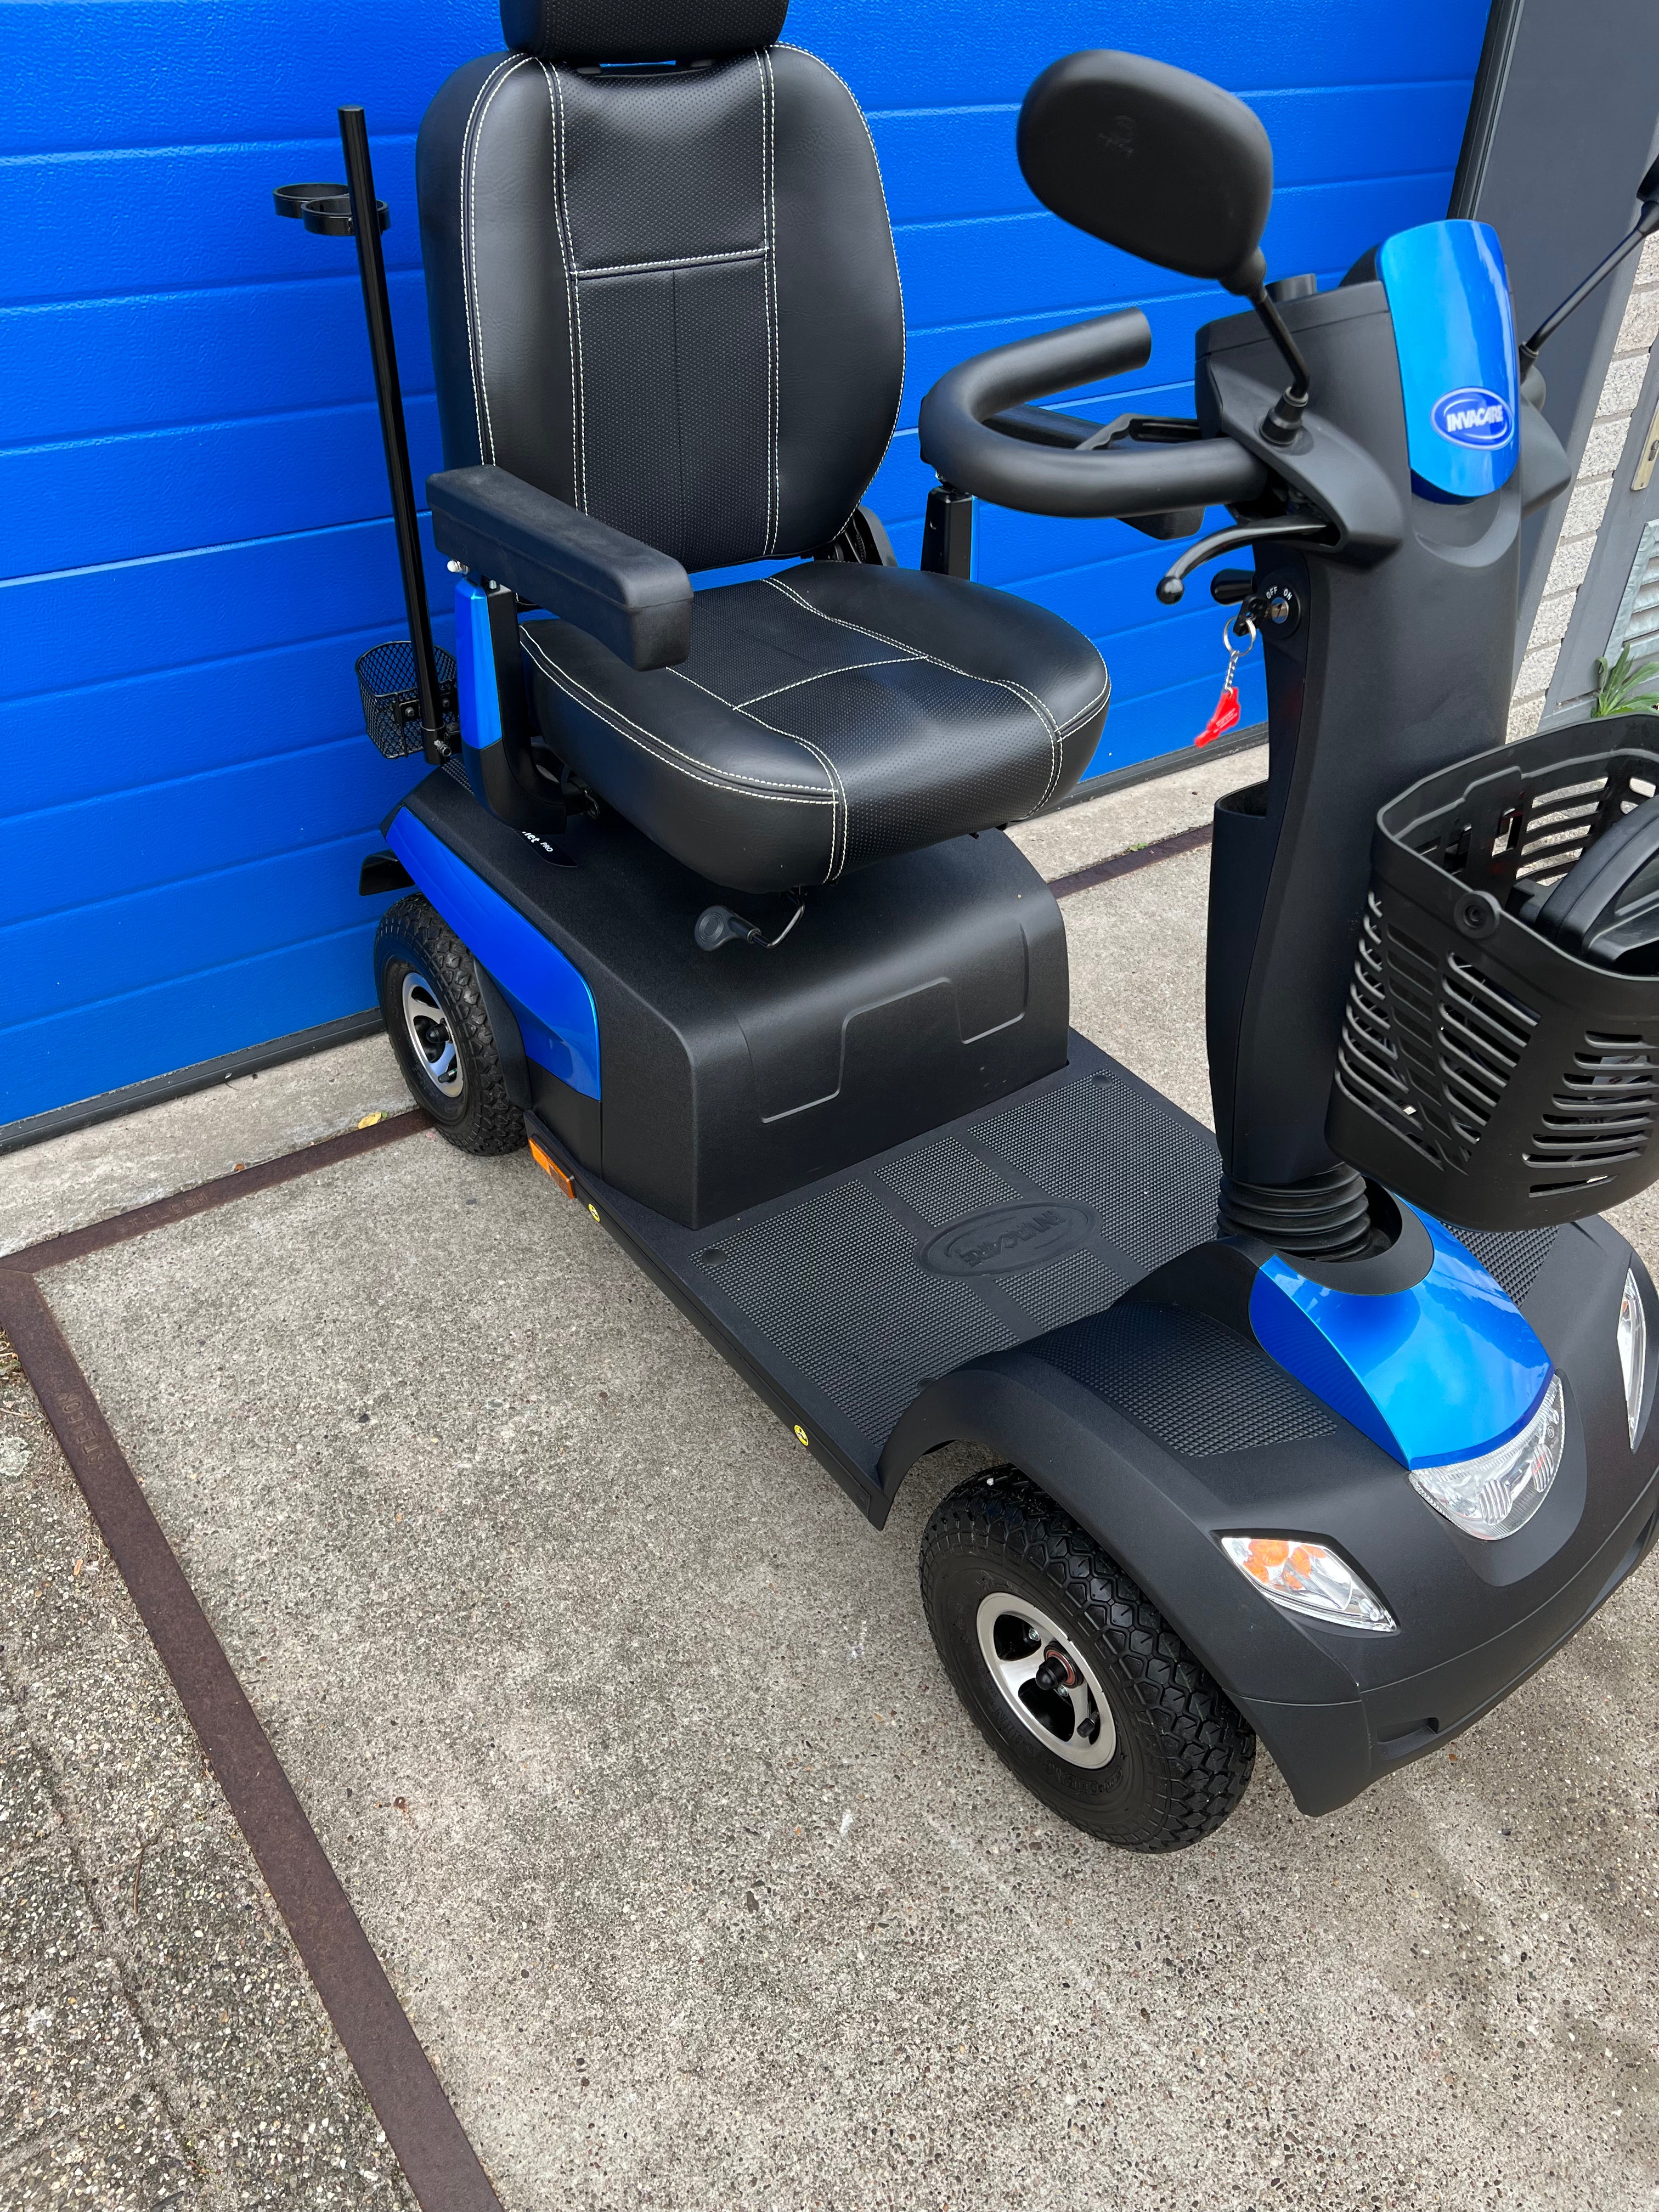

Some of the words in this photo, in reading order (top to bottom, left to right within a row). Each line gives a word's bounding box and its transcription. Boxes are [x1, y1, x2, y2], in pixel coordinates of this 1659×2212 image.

[1447, 405, 1504, 433] INVACARE
[1266, 586, 1278, 599] OFF
[1283, 588, 1293, 600] ON
[540, 842, 554, 852] PRO
[957, 1210, 1066, 1267] INVACARE
[57, 1393, 106, 1465] STELCON
[994, 1708, 1039, 1758] SHIN
[1043, 1758, 1099, 1795] CHENG
